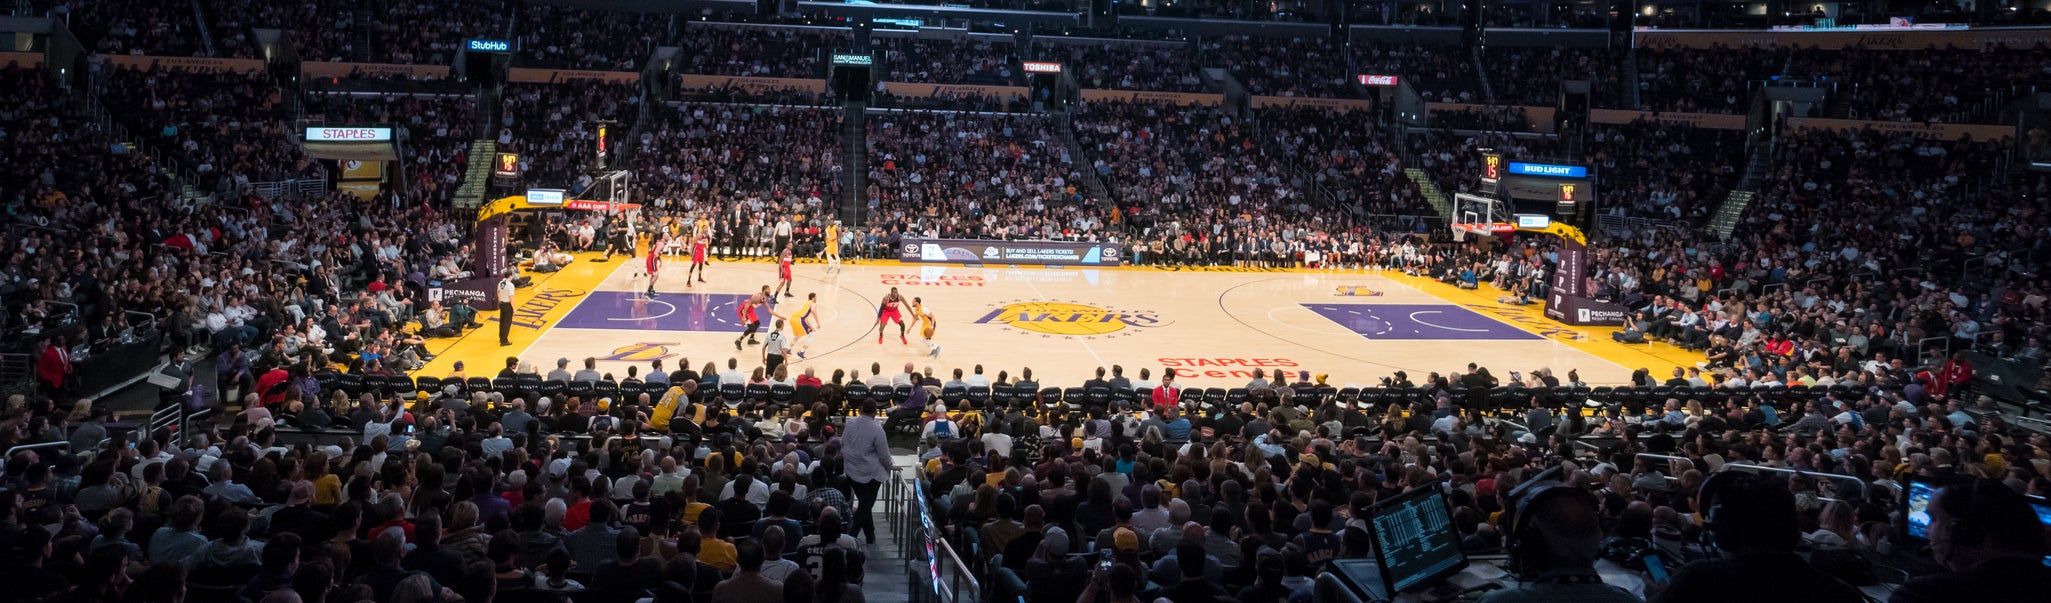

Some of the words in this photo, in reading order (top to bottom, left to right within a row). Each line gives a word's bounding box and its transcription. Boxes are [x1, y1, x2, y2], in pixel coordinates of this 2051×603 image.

[472, 40, 506, 50] StubHub
[1024, 64, 1060, 72] TOSHIBA
[323, 129, 376, 138] STAPLES
[1488, 165, 1496, 178] 15
[974, 308, 1176, 328] LAKERS
[1158, 358, 1299, 366] STAPLES
